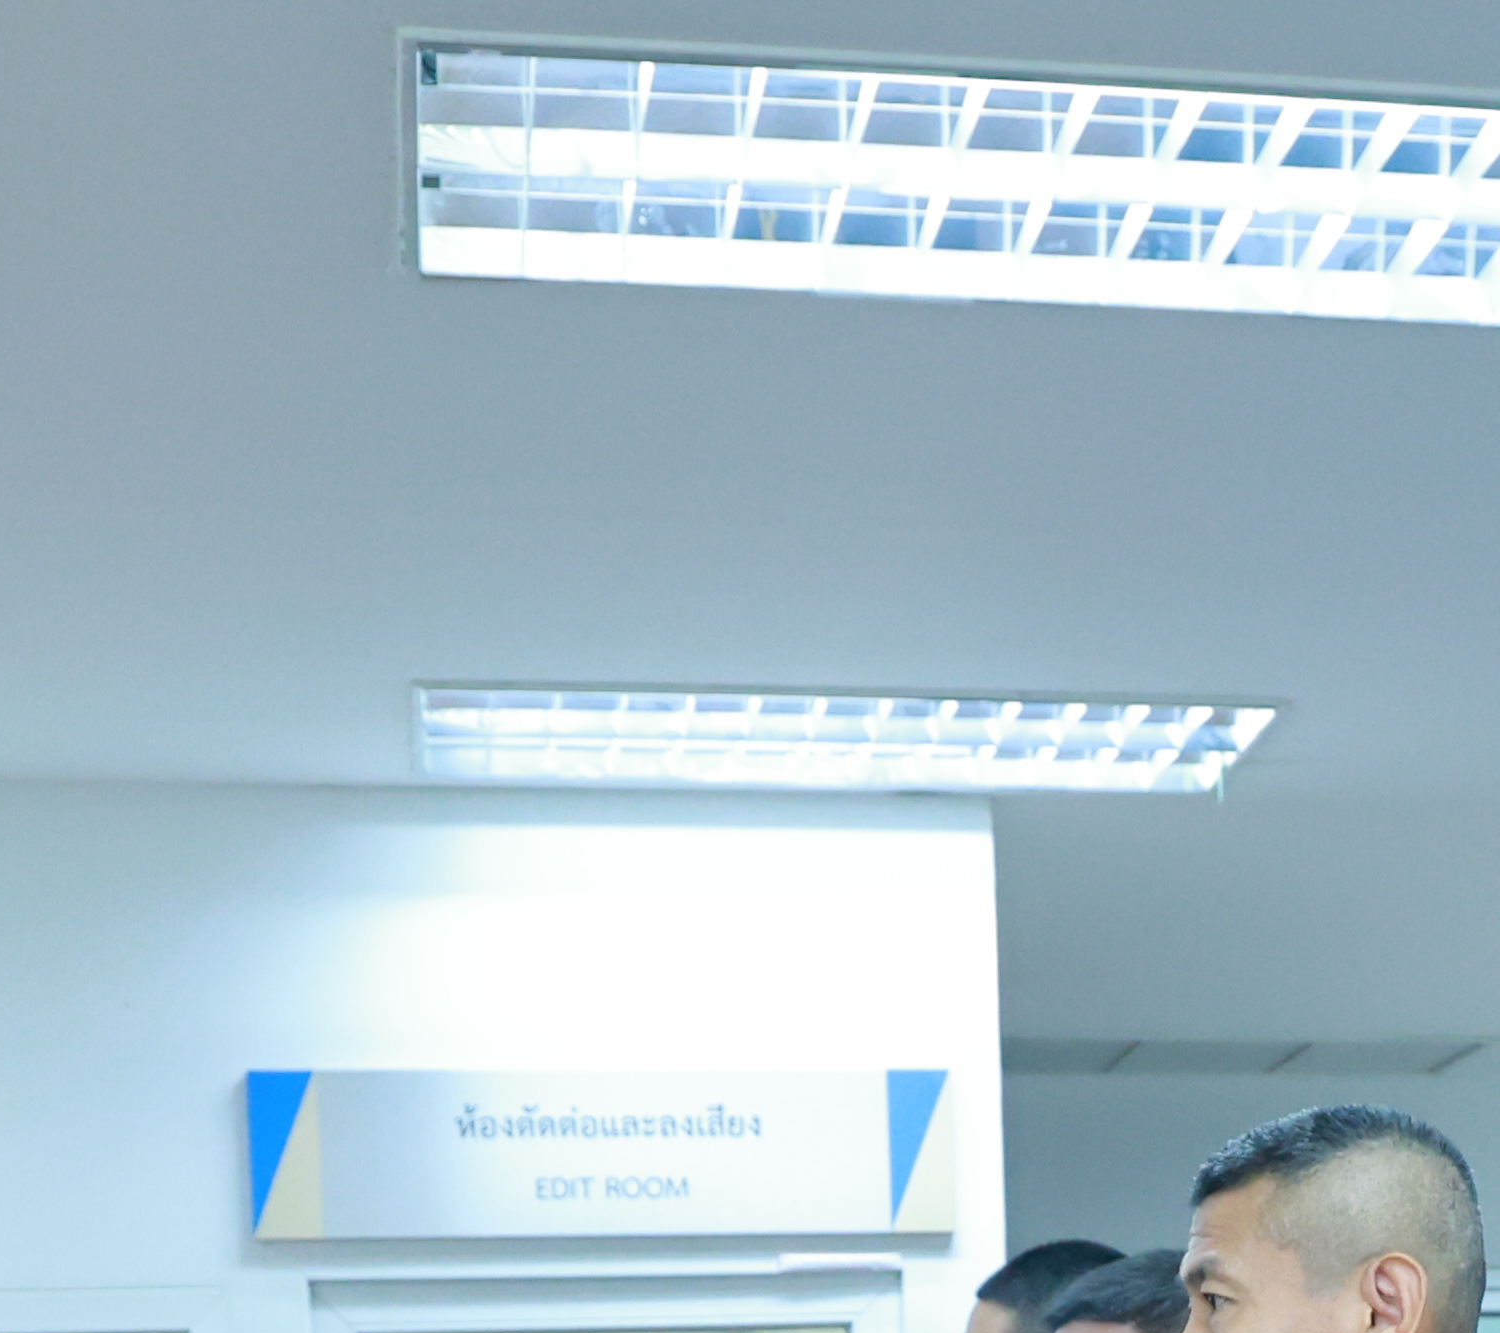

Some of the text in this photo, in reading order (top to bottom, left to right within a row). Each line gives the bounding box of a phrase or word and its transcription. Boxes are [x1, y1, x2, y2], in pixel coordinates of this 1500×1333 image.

[454, 1102, 762, 1139] ห้องตัดต่อและลงเสียง
[535, 1175, 690, 1200] EDIT ROOM
